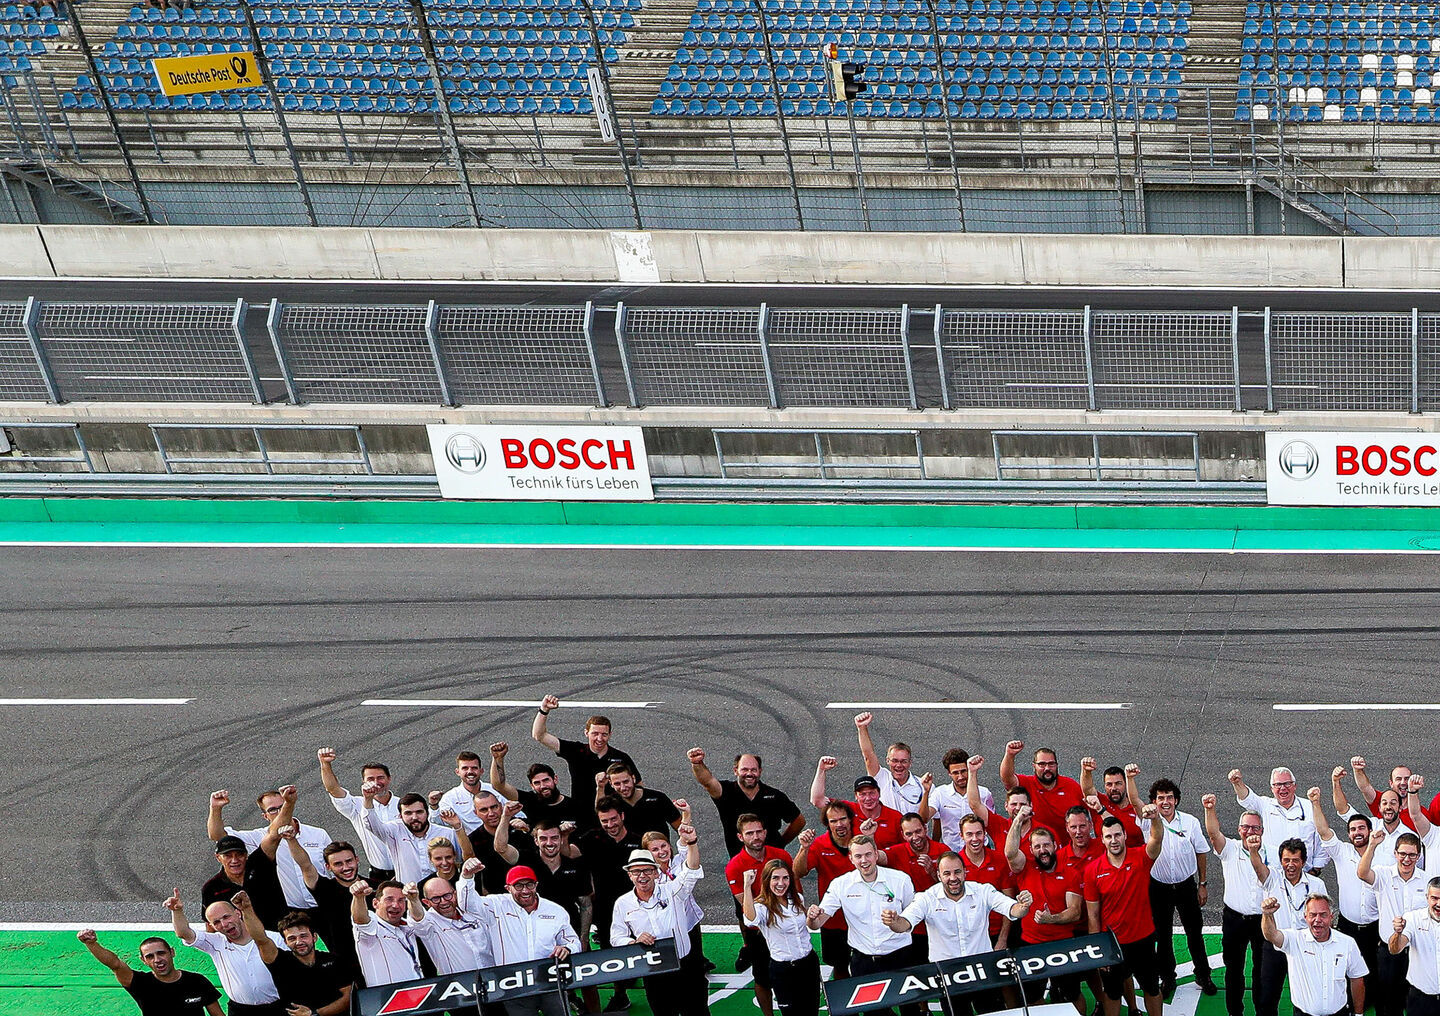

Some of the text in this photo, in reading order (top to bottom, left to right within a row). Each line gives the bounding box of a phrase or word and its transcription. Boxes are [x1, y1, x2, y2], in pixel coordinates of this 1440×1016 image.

[168, 67, 232, 86] Deutsche Post
[592, 73, 611, 138] 100
[500, 438, 635, 470] BOSCH
[508, 476, 639, 490] Technik fürs Leben
[1336, 482, 1390, 495] Technik
[1394, 482, 1420, 495] fürs
[438, 950, 662, 1000] Audi Sport
[900, 944, 1104, 995] Audi Sport
